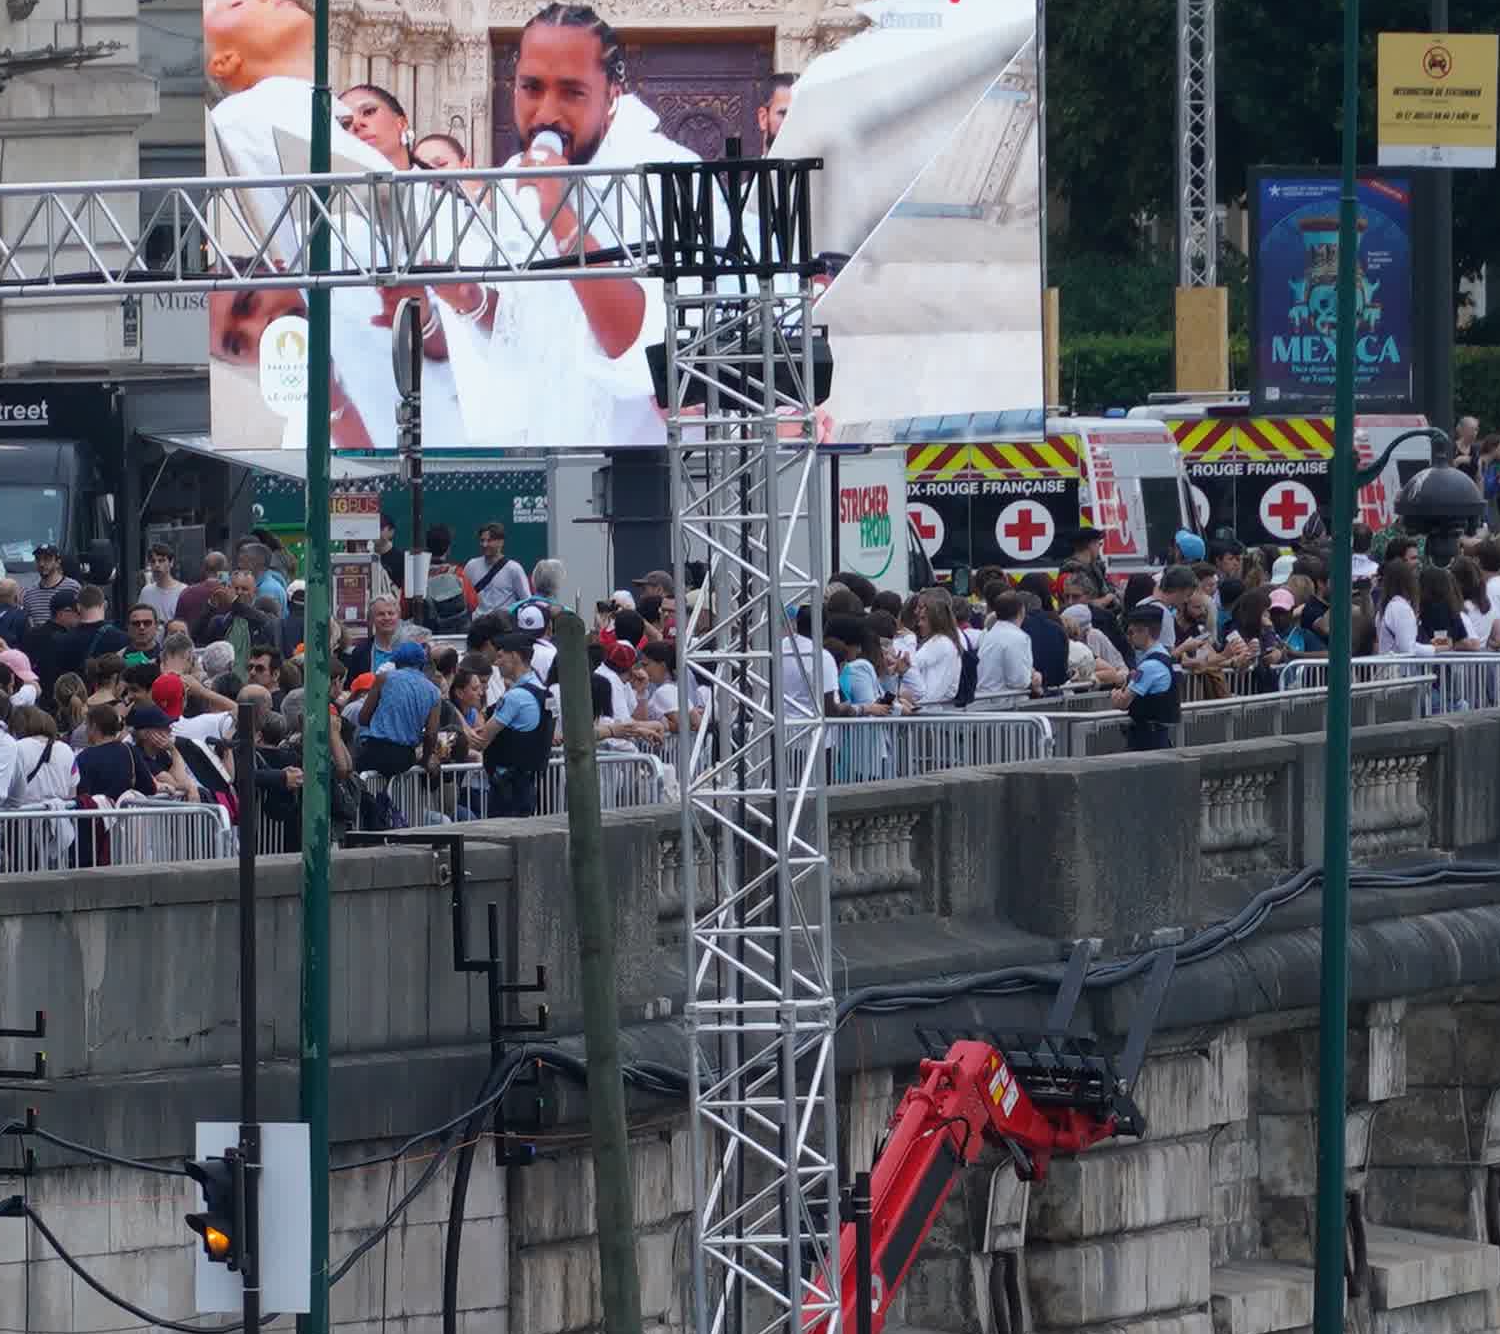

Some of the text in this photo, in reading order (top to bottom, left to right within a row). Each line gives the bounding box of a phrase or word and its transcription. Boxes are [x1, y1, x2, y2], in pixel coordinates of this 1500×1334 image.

[1271, 334, 1401, 364] MEXCA
[1246, 460, 1329, 477] FRANÇAISE
[981, 478, 1066, 499] FRANÇAISE
[840, 484, 889, 524] STRICHER
[860, 513, 891, 549] FROID
